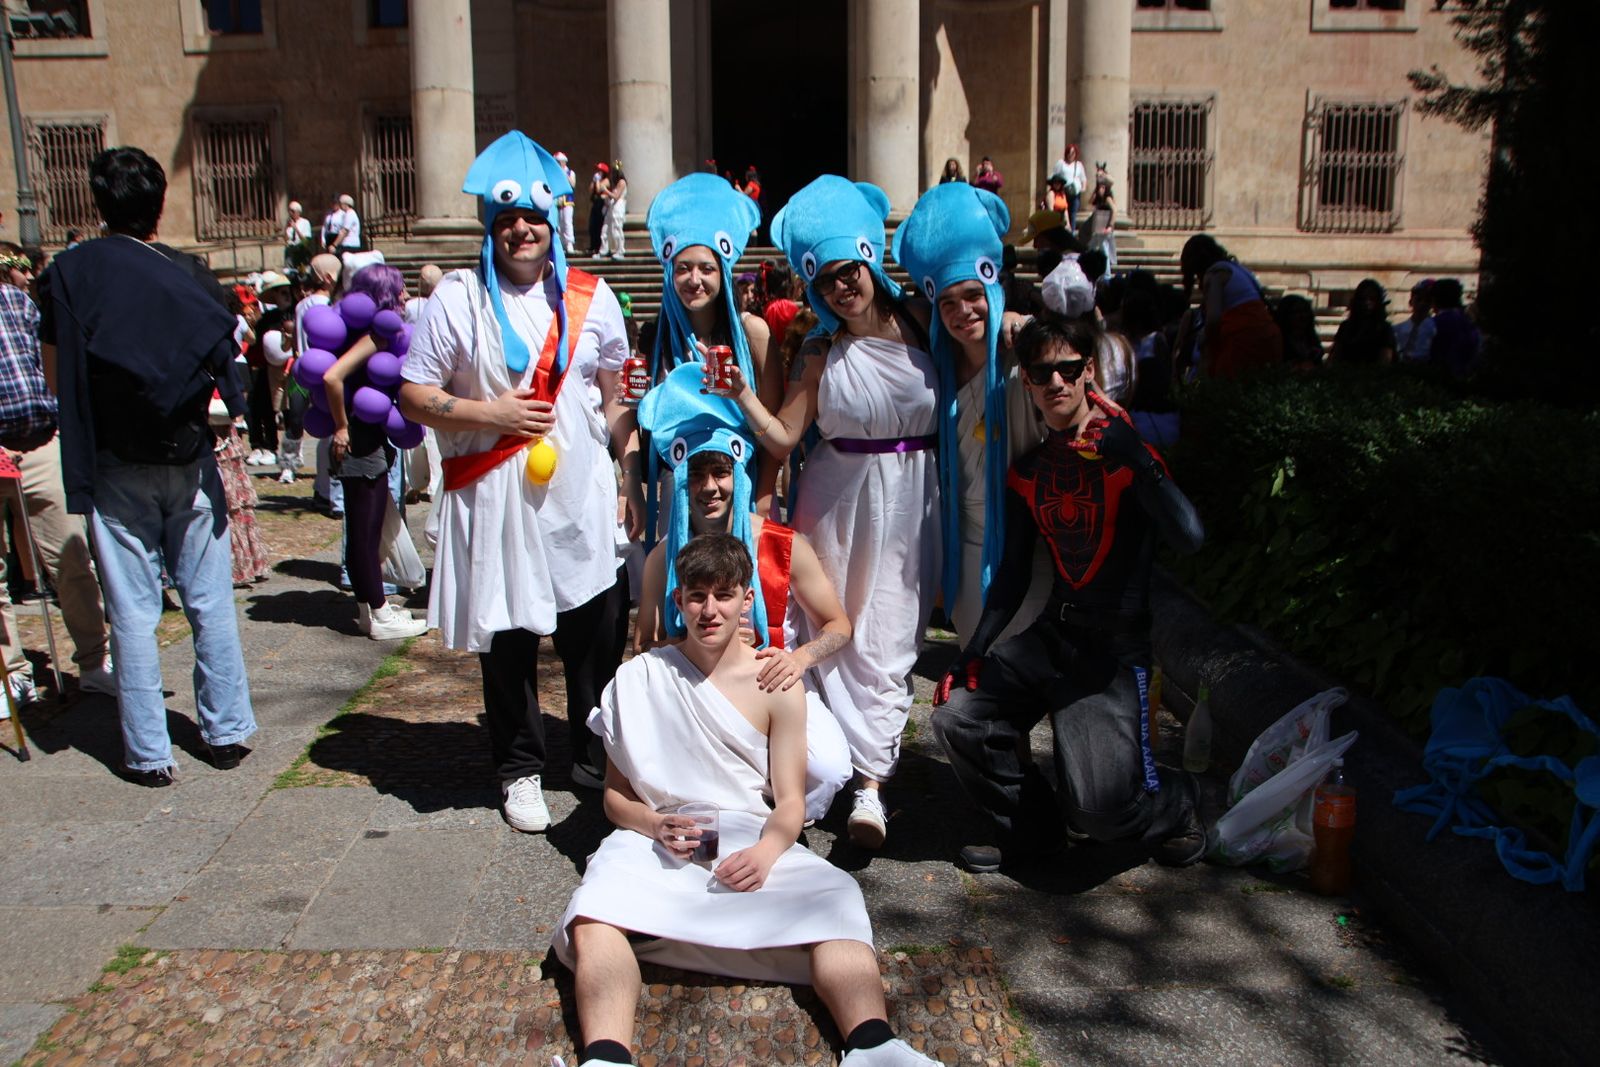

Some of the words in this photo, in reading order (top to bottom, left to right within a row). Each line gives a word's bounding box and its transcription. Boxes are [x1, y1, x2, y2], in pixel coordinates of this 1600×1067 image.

[1136, 671, 1148, 702] BULL
[1140, 703, 1149, 719] TE
[1141, 723, 1149, 741] DA
